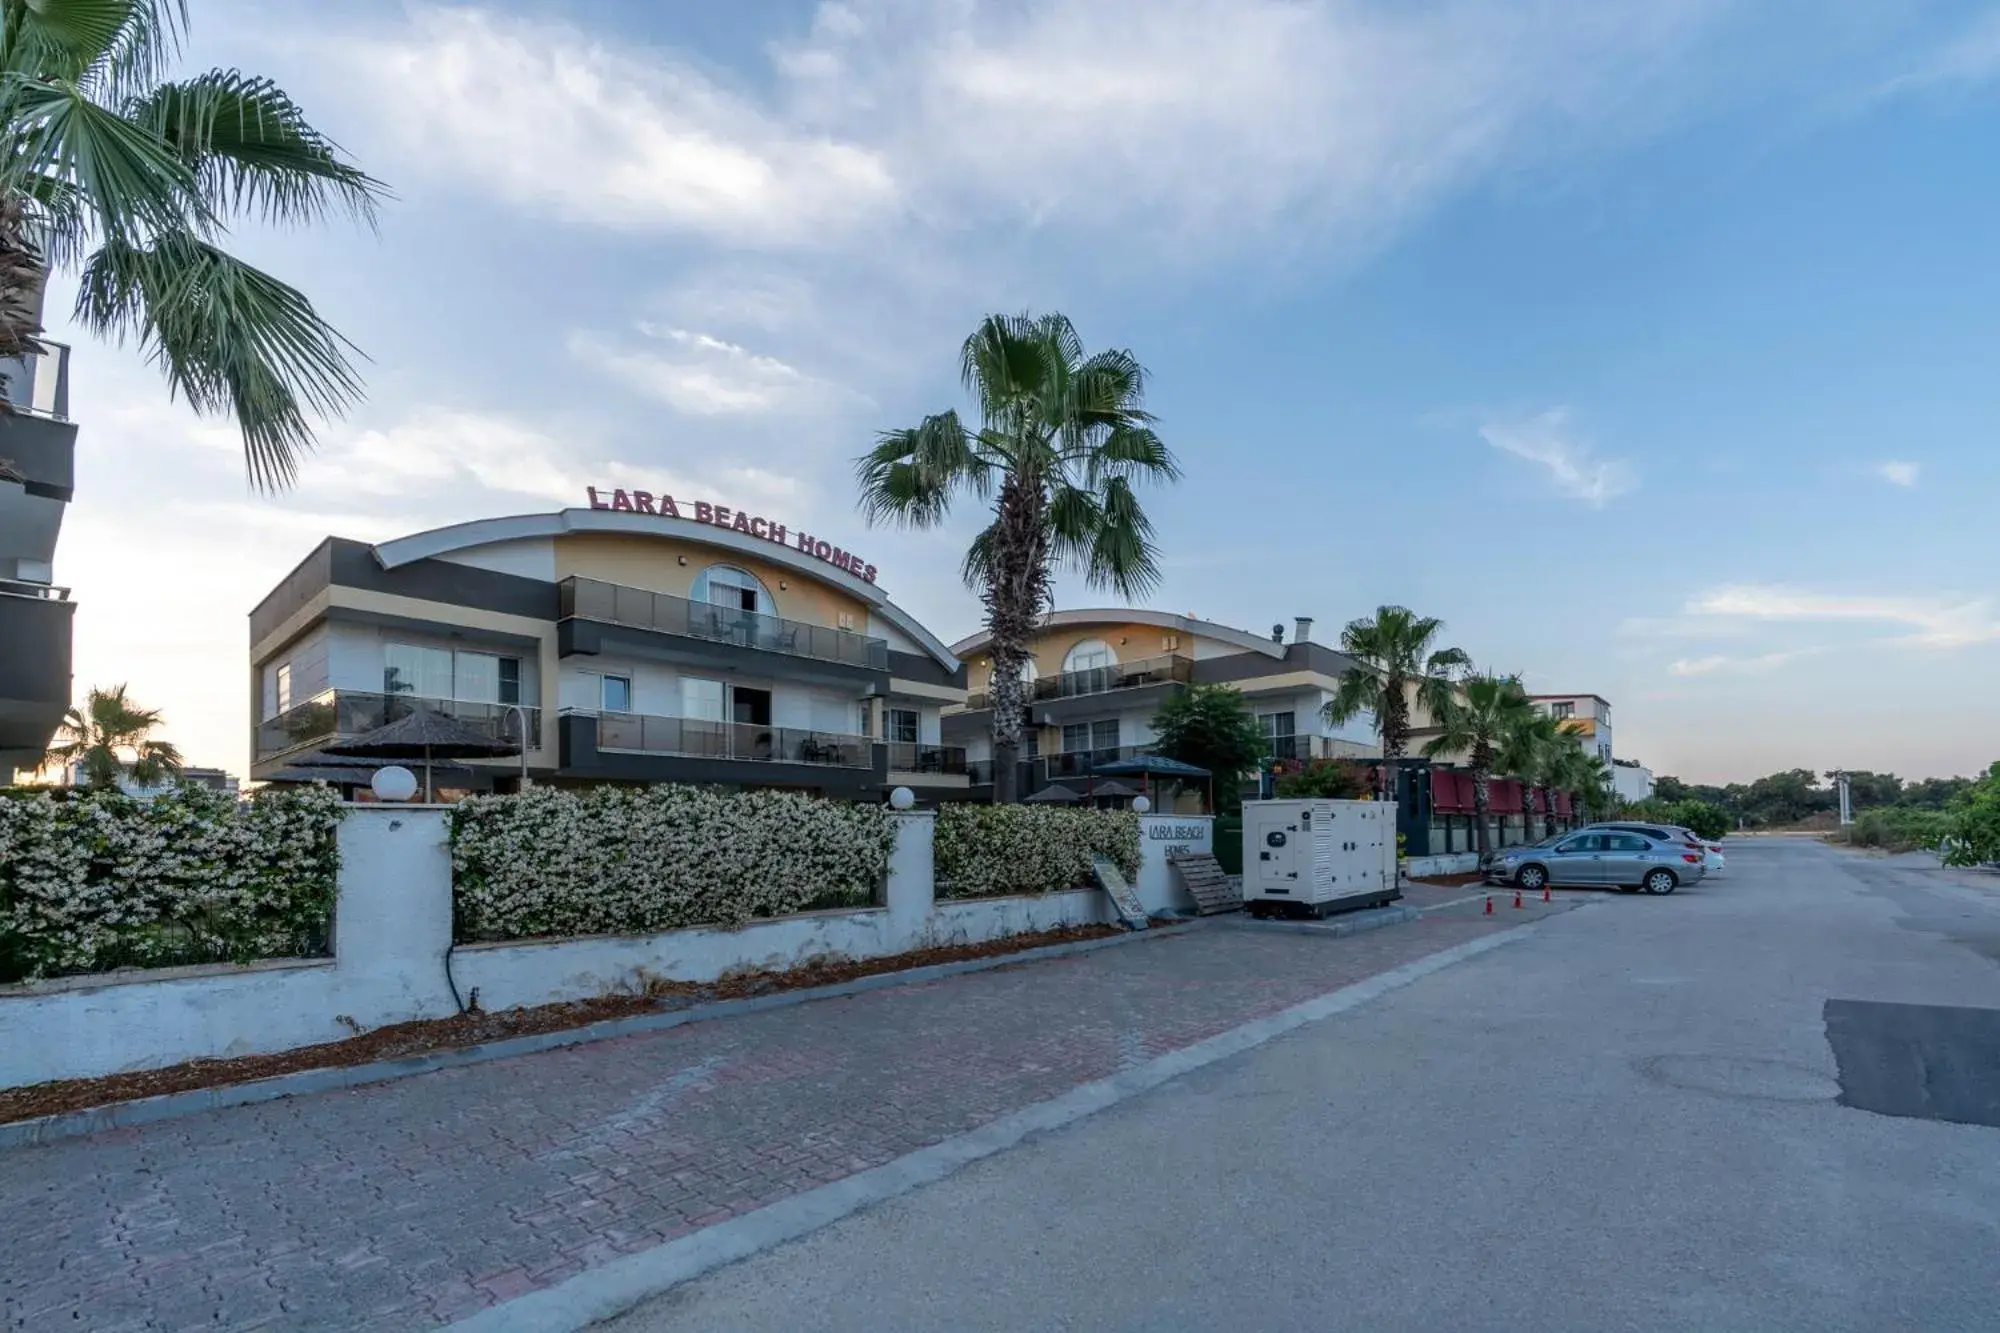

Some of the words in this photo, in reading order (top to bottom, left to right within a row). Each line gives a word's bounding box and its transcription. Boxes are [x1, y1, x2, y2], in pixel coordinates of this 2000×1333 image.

[587, 486, 679, 518] LARA
[695, 501, 787, 544] BEACH
[798, 532, 878, 583] HOMES
[1149, 825, 1173, 840] LARA
[1175, 826, 1204, 840] BEACH
